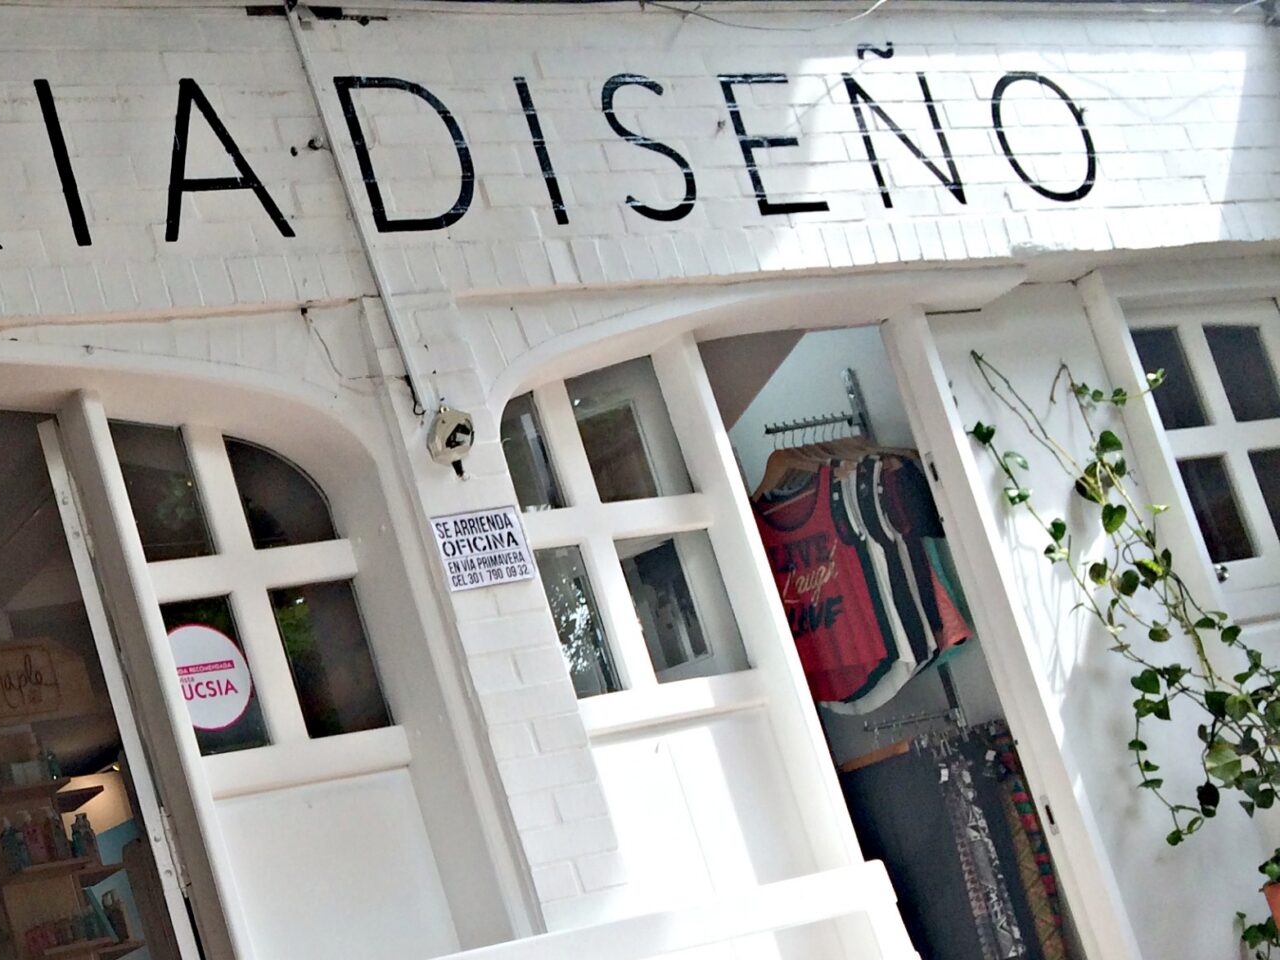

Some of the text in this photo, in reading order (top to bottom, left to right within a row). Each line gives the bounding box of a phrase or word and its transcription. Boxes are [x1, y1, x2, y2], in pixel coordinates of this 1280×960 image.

[435, 513, 513, 539] SE ARRIENDA
[442, 531, 519, 557] OFICINA
[448, 560, 461, 575] EN
[477, 552, 525, 569] PRIMAVERA
[451, 574, 467, 587] CEL
[468, 571, 483, 585] 301
[488, 567, 504, 581] 790
[518, 564, 528, 575] 32
[181, 679, 238, 701] UCSIA
